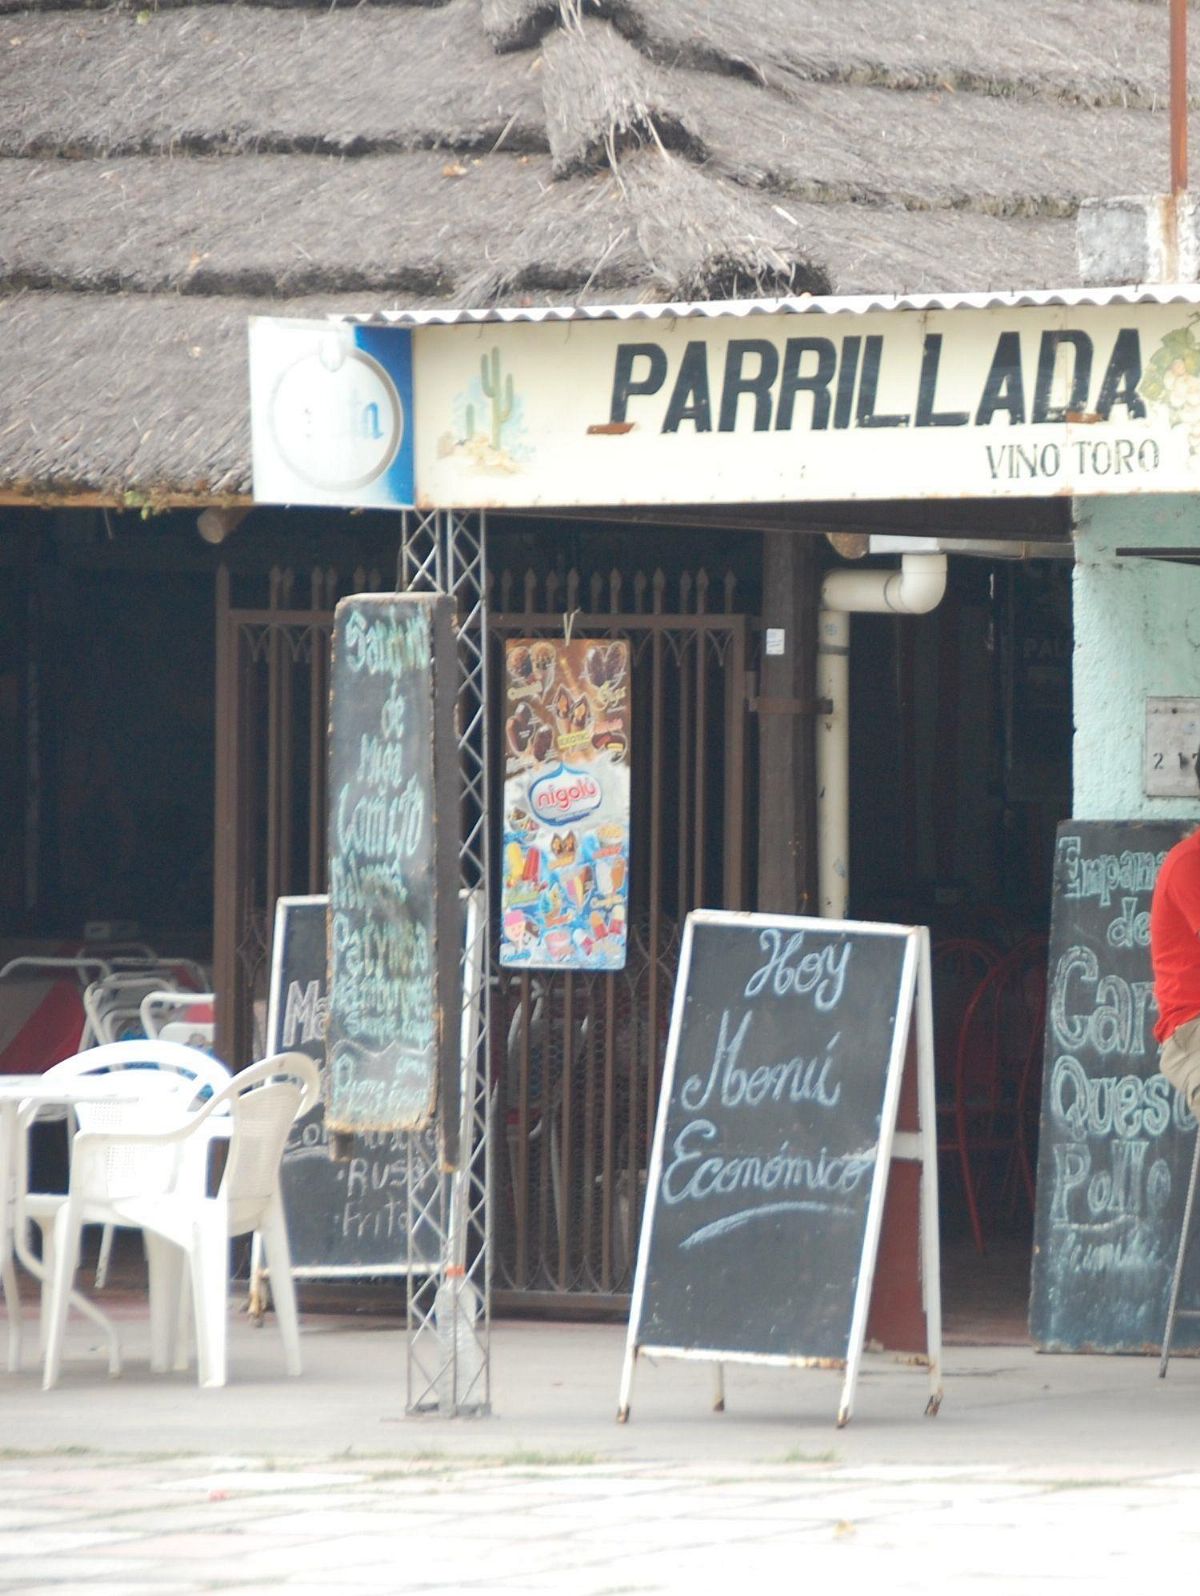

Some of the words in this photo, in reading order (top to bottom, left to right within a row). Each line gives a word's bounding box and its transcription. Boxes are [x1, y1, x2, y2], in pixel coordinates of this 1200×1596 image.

[587, 327, 1149, 436] PARRILLADA
[985, 442, 1060, 480] VINO
[1071, 437, 1161, 475] TORO
[1106, 896, 1151, 948] de
[743, 928, 853, 1011] Hoy
[1051, 944, 1164, 1055] Car
[681, 1008, 842, 1113] Menú
[660, 1117, 876, 1204] Económico
[1050, 1140, 1171, 1224] Pollo
